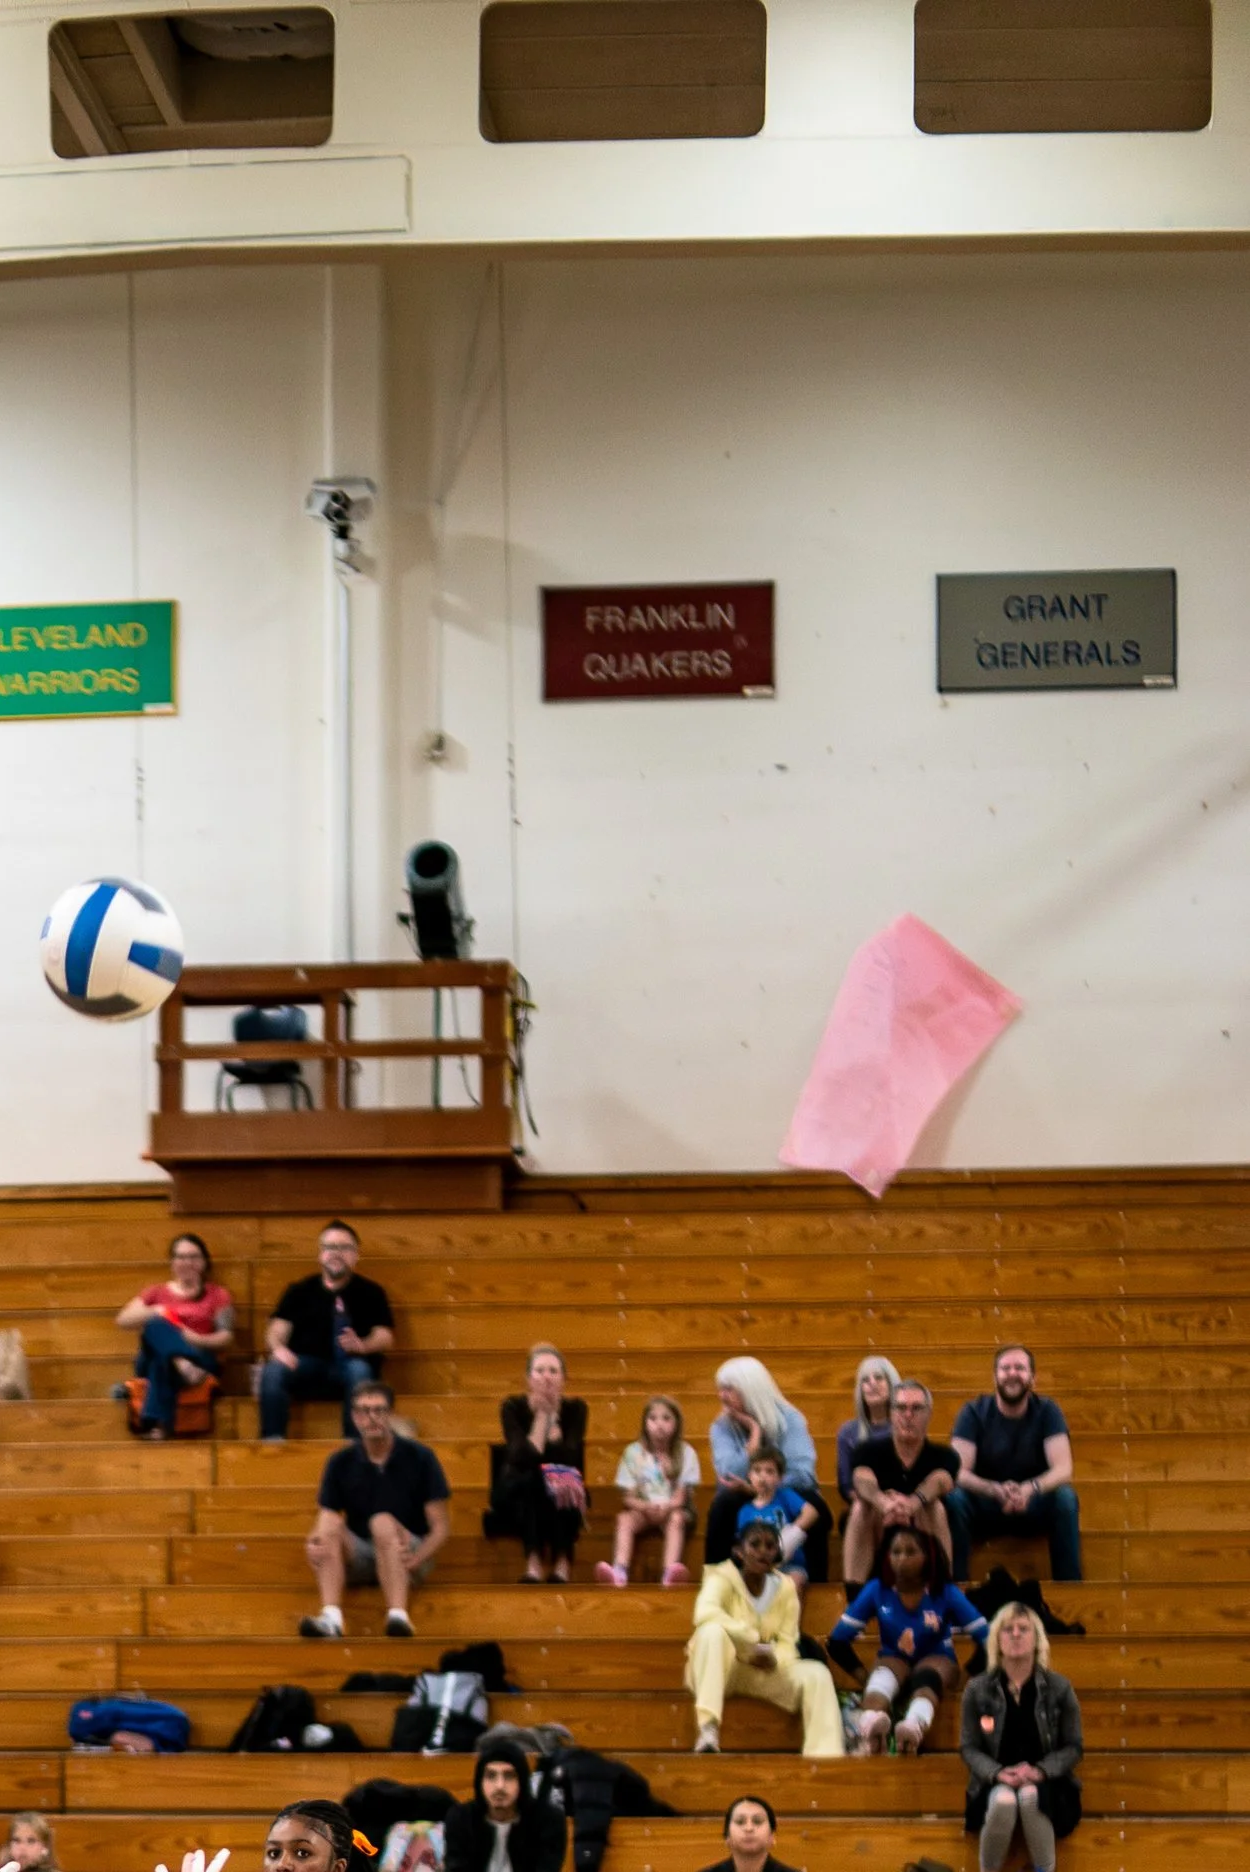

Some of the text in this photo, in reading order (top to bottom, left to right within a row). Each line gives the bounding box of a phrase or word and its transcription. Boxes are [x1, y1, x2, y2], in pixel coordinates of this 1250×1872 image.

[585, 601, 737, 635] FRANKLIN
[1003, 592, 1108, 622] GRANT
[583, 648, 734, 682] QUAKERS
[975, 639, 1142, 671] GENERALS
